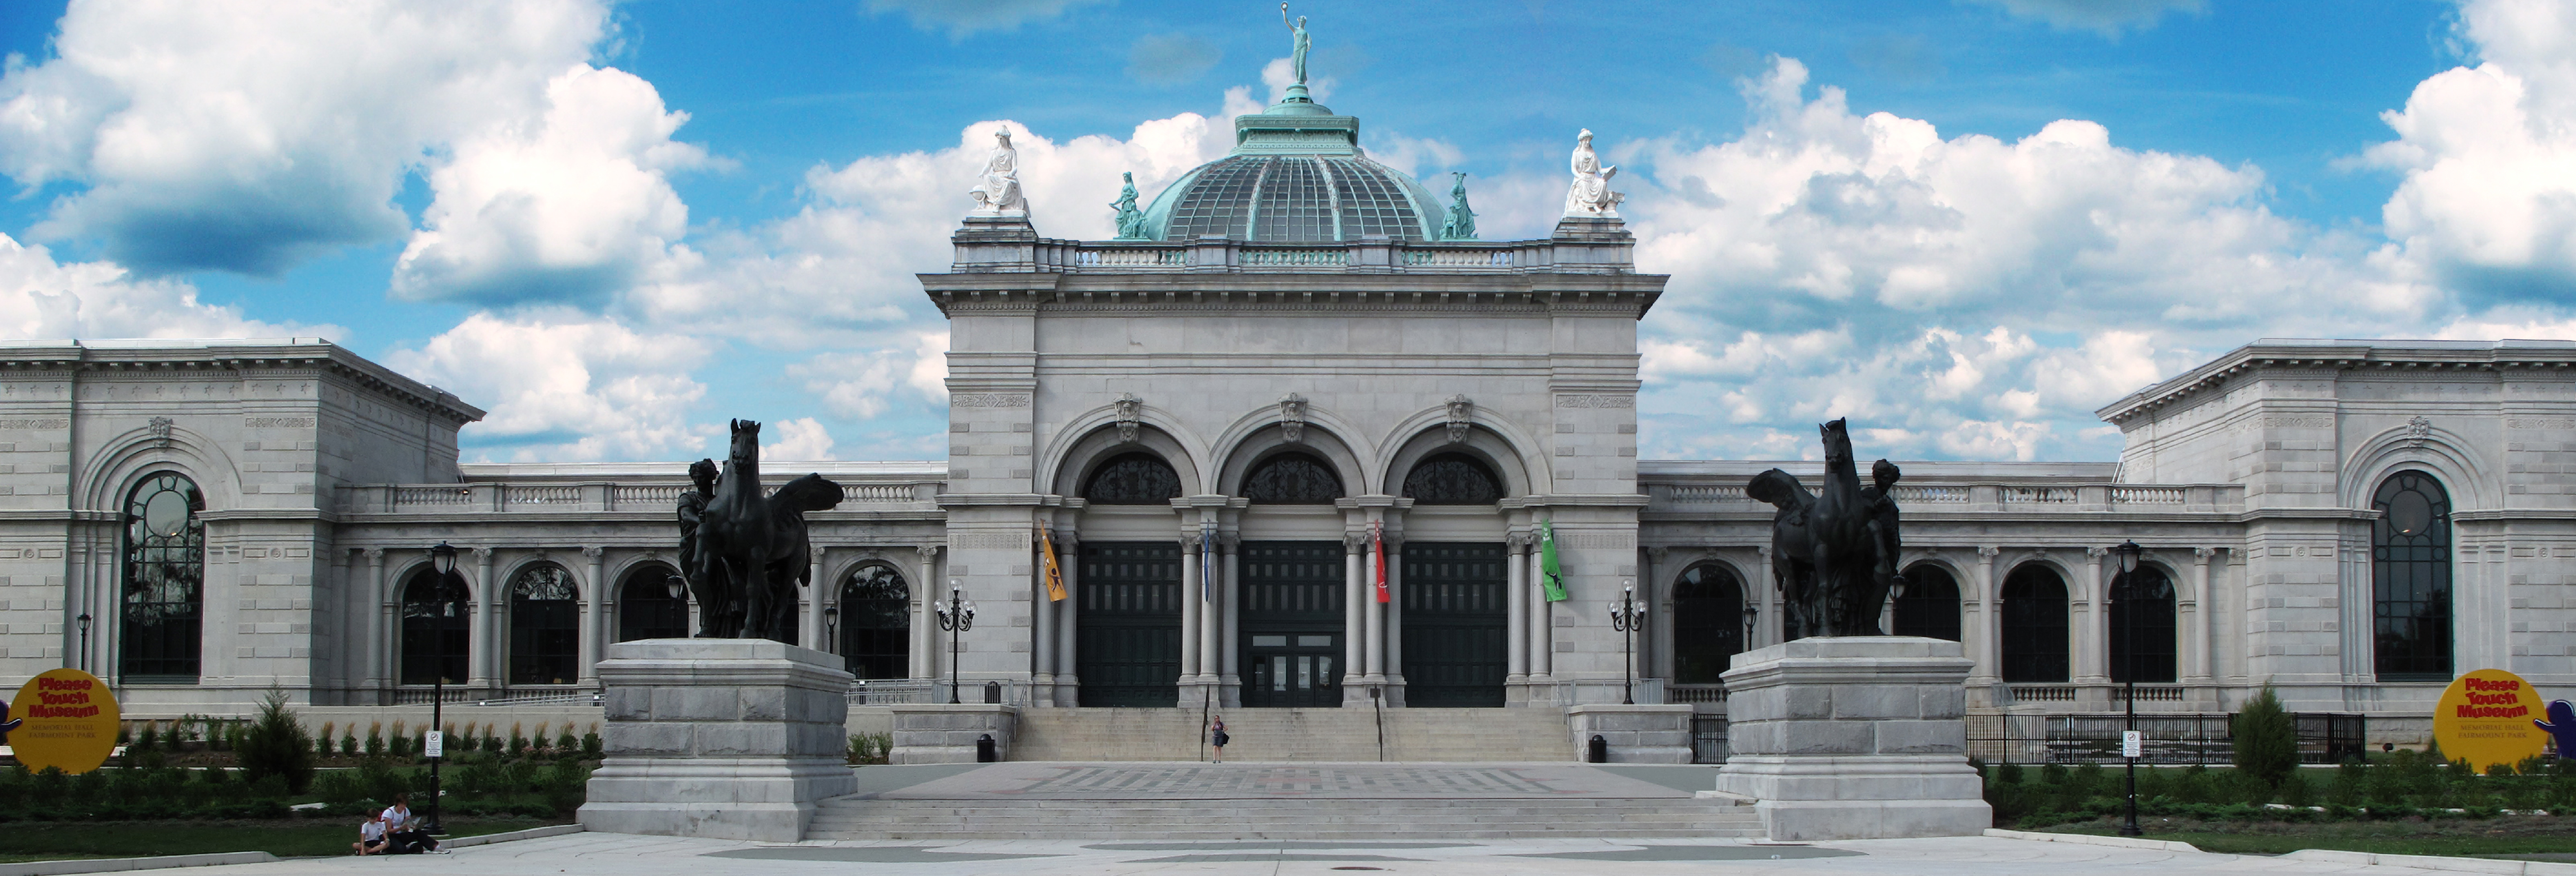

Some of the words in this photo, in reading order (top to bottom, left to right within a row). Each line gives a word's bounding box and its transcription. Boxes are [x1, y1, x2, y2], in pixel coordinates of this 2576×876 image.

[39, 678, 92, 691] Please
[2465, 678, 2519, 691] Please
[37, 691, 89, 704] Touch
[2465, 692, 2518, 704] Touch
[28, 705, 99, 718] Museum
[2457, 705, 2528, 718] Museum
